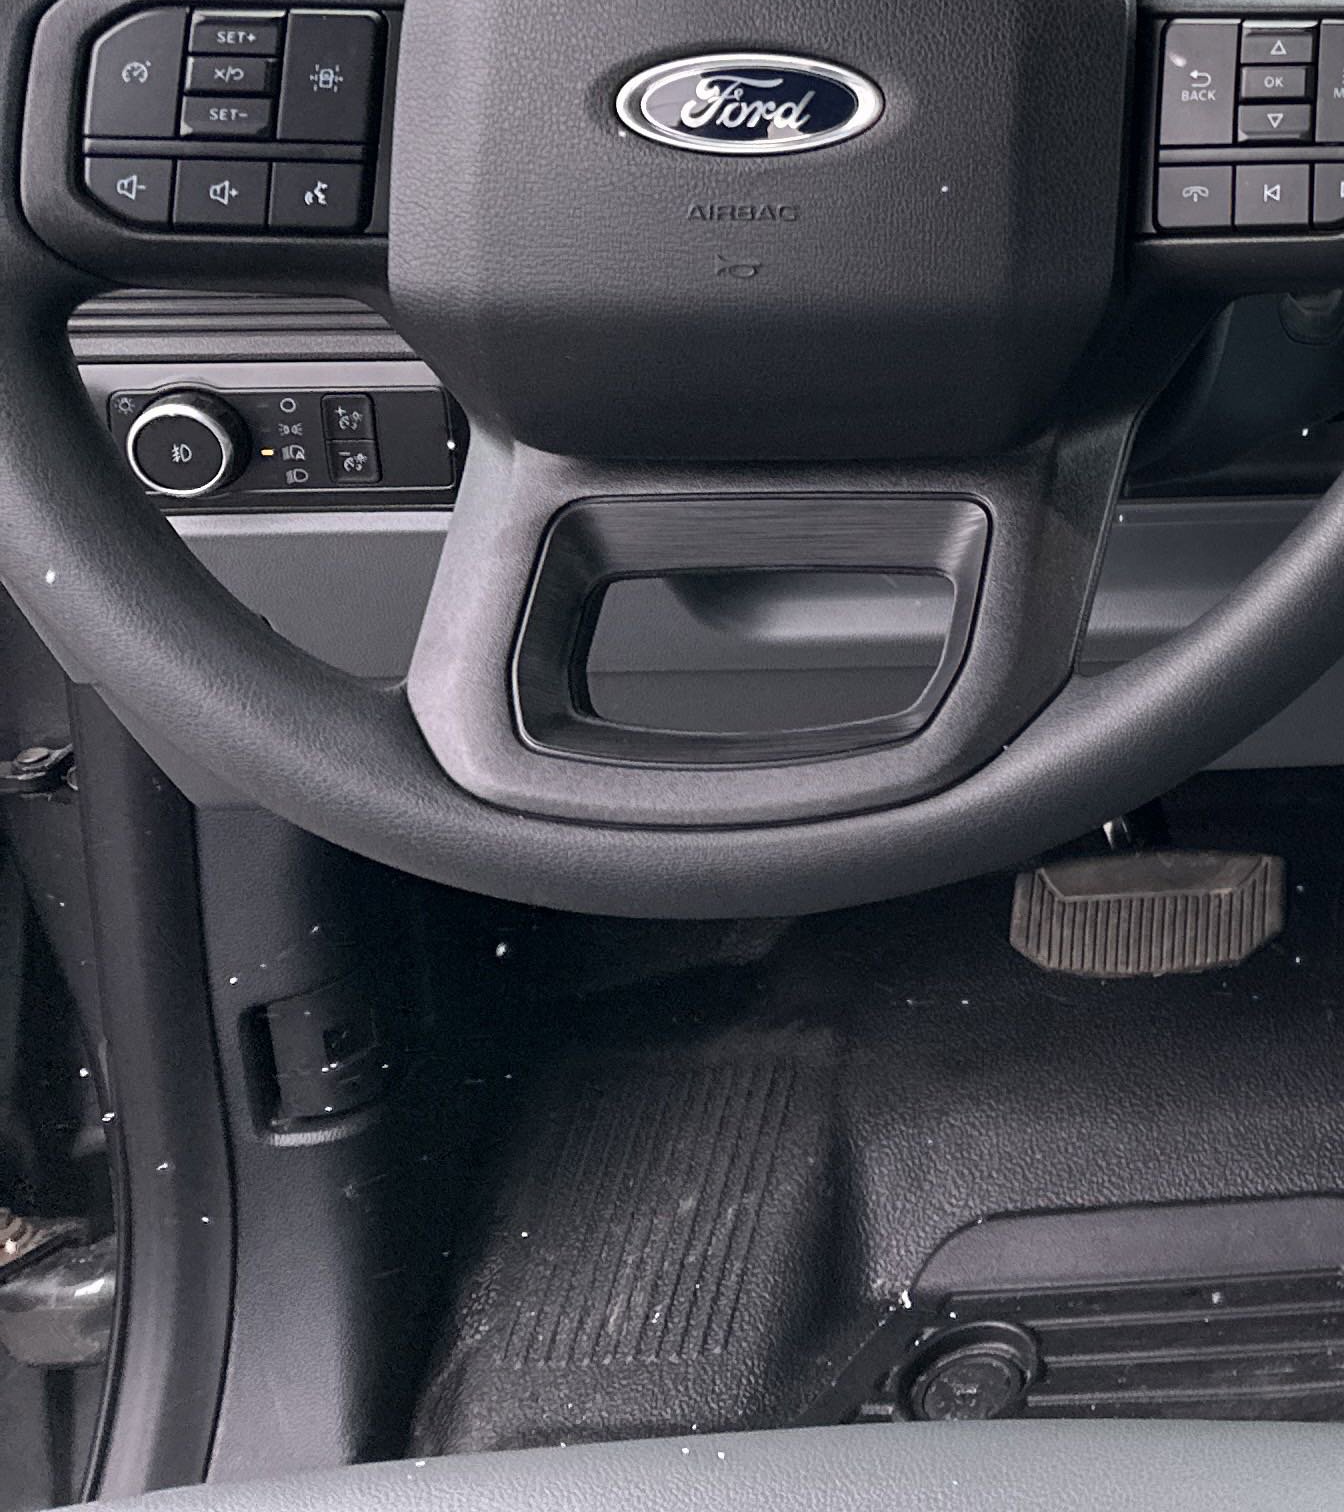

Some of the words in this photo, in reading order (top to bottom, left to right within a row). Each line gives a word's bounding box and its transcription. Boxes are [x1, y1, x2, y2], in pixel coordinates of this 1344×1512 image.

[1264, 76, 1284, 88] OK
[680, 75, 816, 129] Ford
[1181, 89, 1216, 102] BACK
[687, 204, 798, 222] AIRBAG
